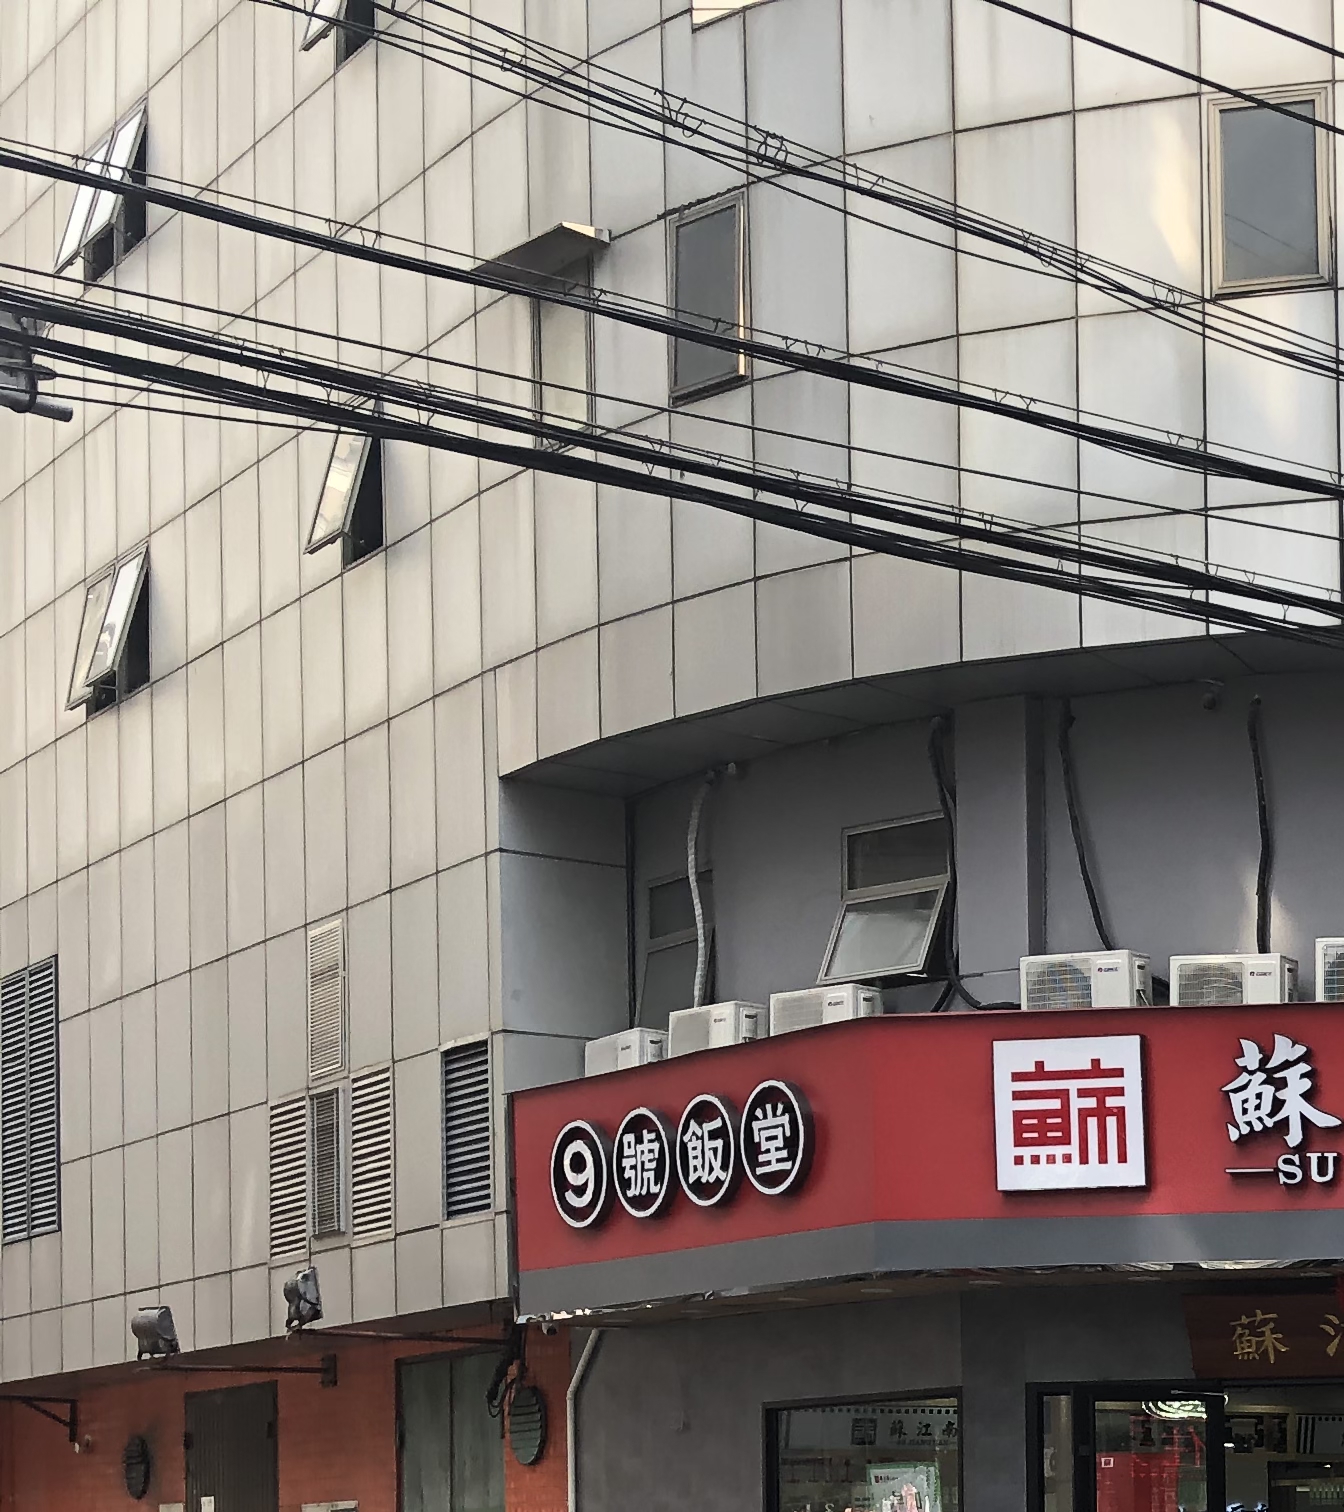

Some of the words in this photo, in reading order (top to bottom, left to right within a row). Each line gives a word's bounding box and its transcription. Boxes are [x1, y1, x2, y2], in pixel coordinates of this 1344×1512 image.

[558, 1094, 798, 1214] 9號飯堂
[1277, 1152, 1338, 1185] SU
